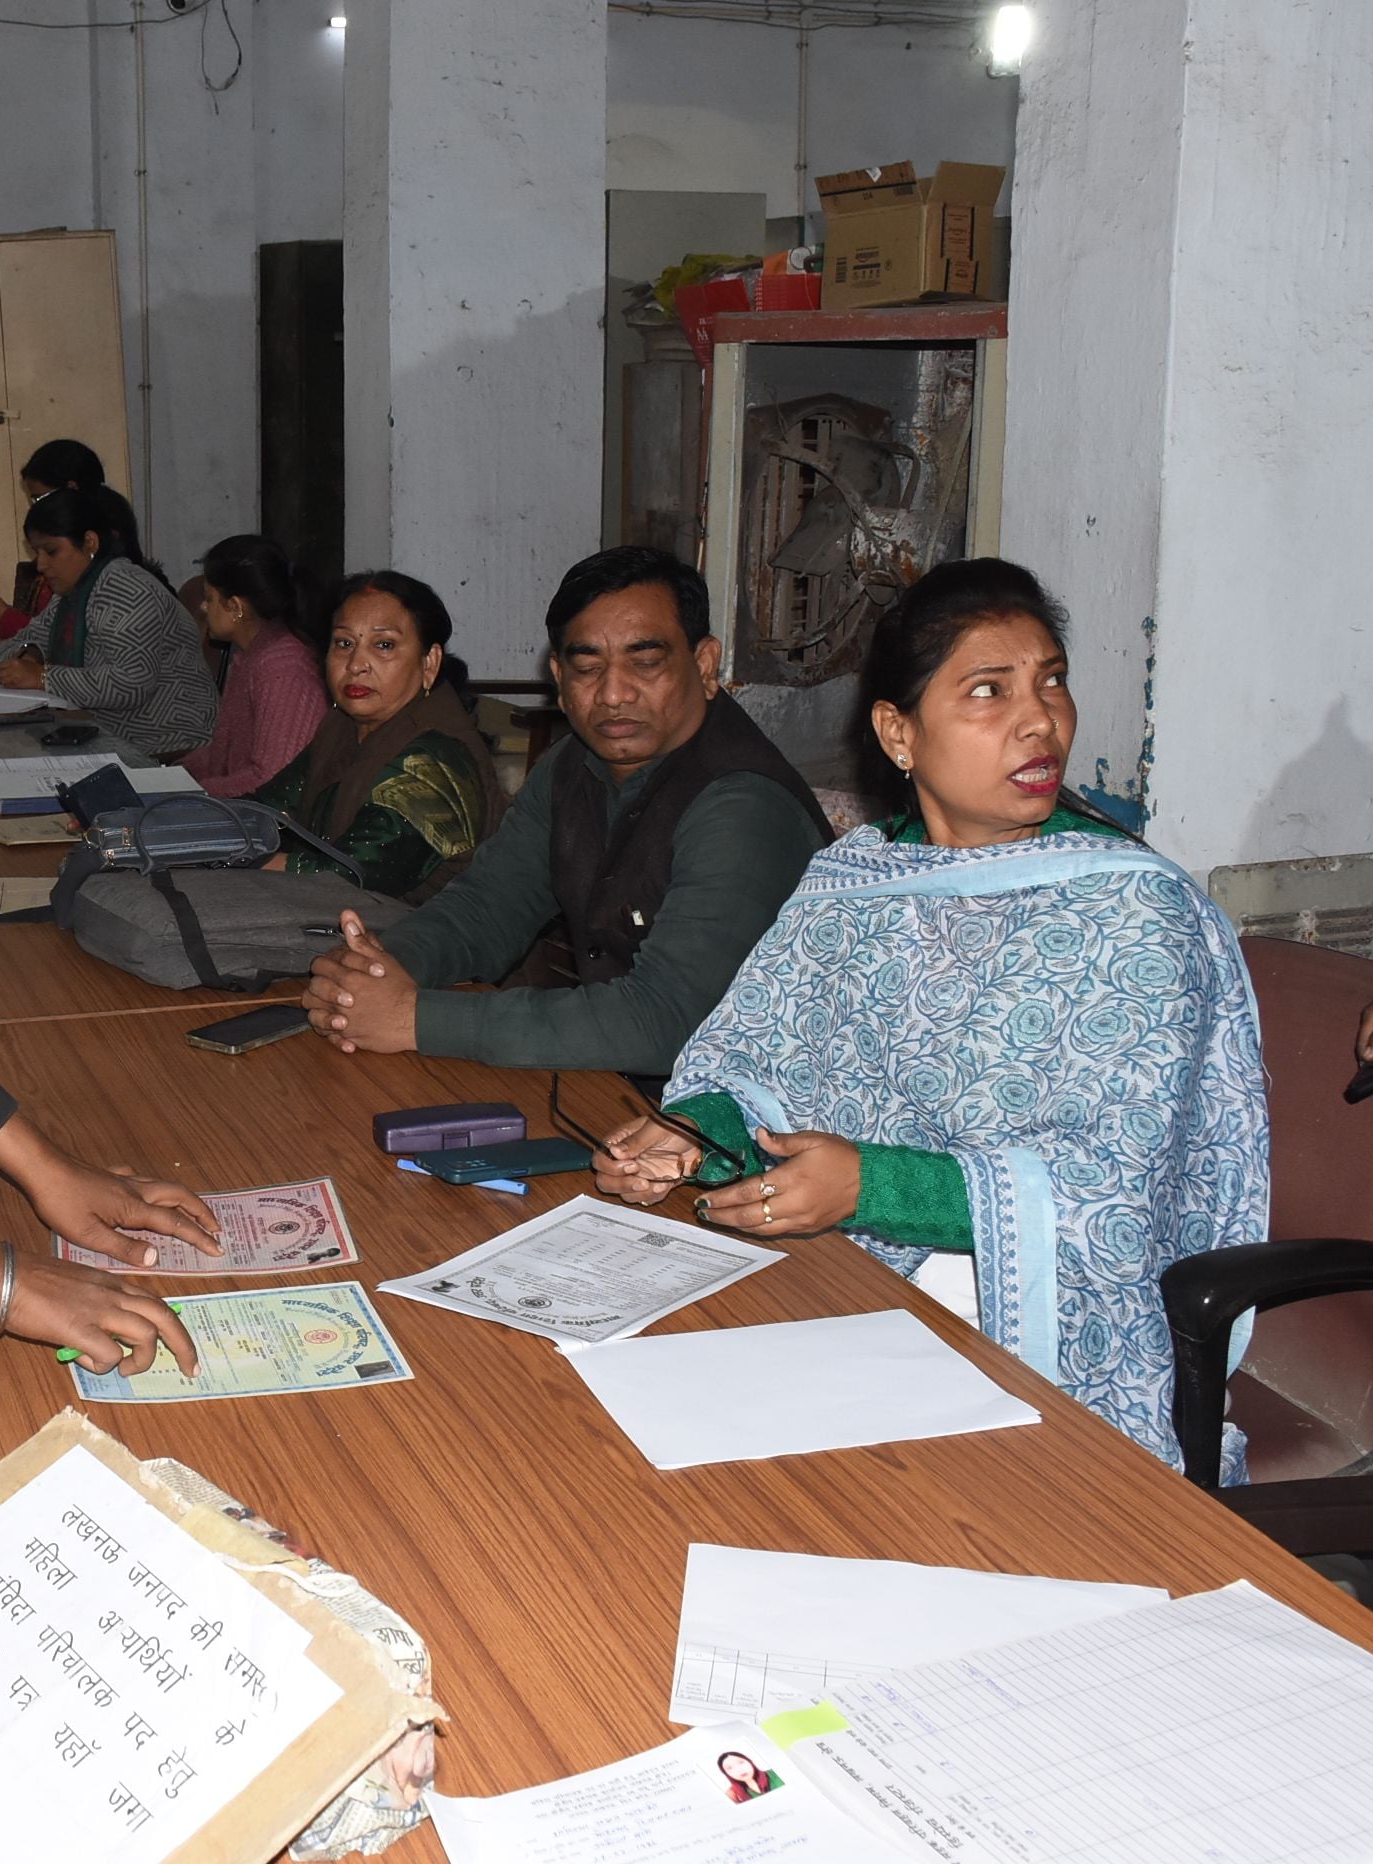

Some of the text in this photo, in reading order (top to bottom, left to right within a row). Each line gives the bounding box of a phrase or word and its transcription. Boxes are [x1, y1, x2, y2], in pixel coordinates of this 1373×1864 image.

[24, 1536, 78, 1591] महिला
[215, 1719, 246, 1746] के
[61, 1503, 128, 1564] लखनऊ
[128, 1560, 189, 1621] जनपद
[190, 1616, 224, 1651] की
[9, 1675, 40, 1712] पत्र
[108, 1782, 152, 1830] जमा
[37, 1624, 121, 1708] परिचालक
[123, 1711, 158, 1751] पद
[157, 1746, 198, 1799] हेतु
